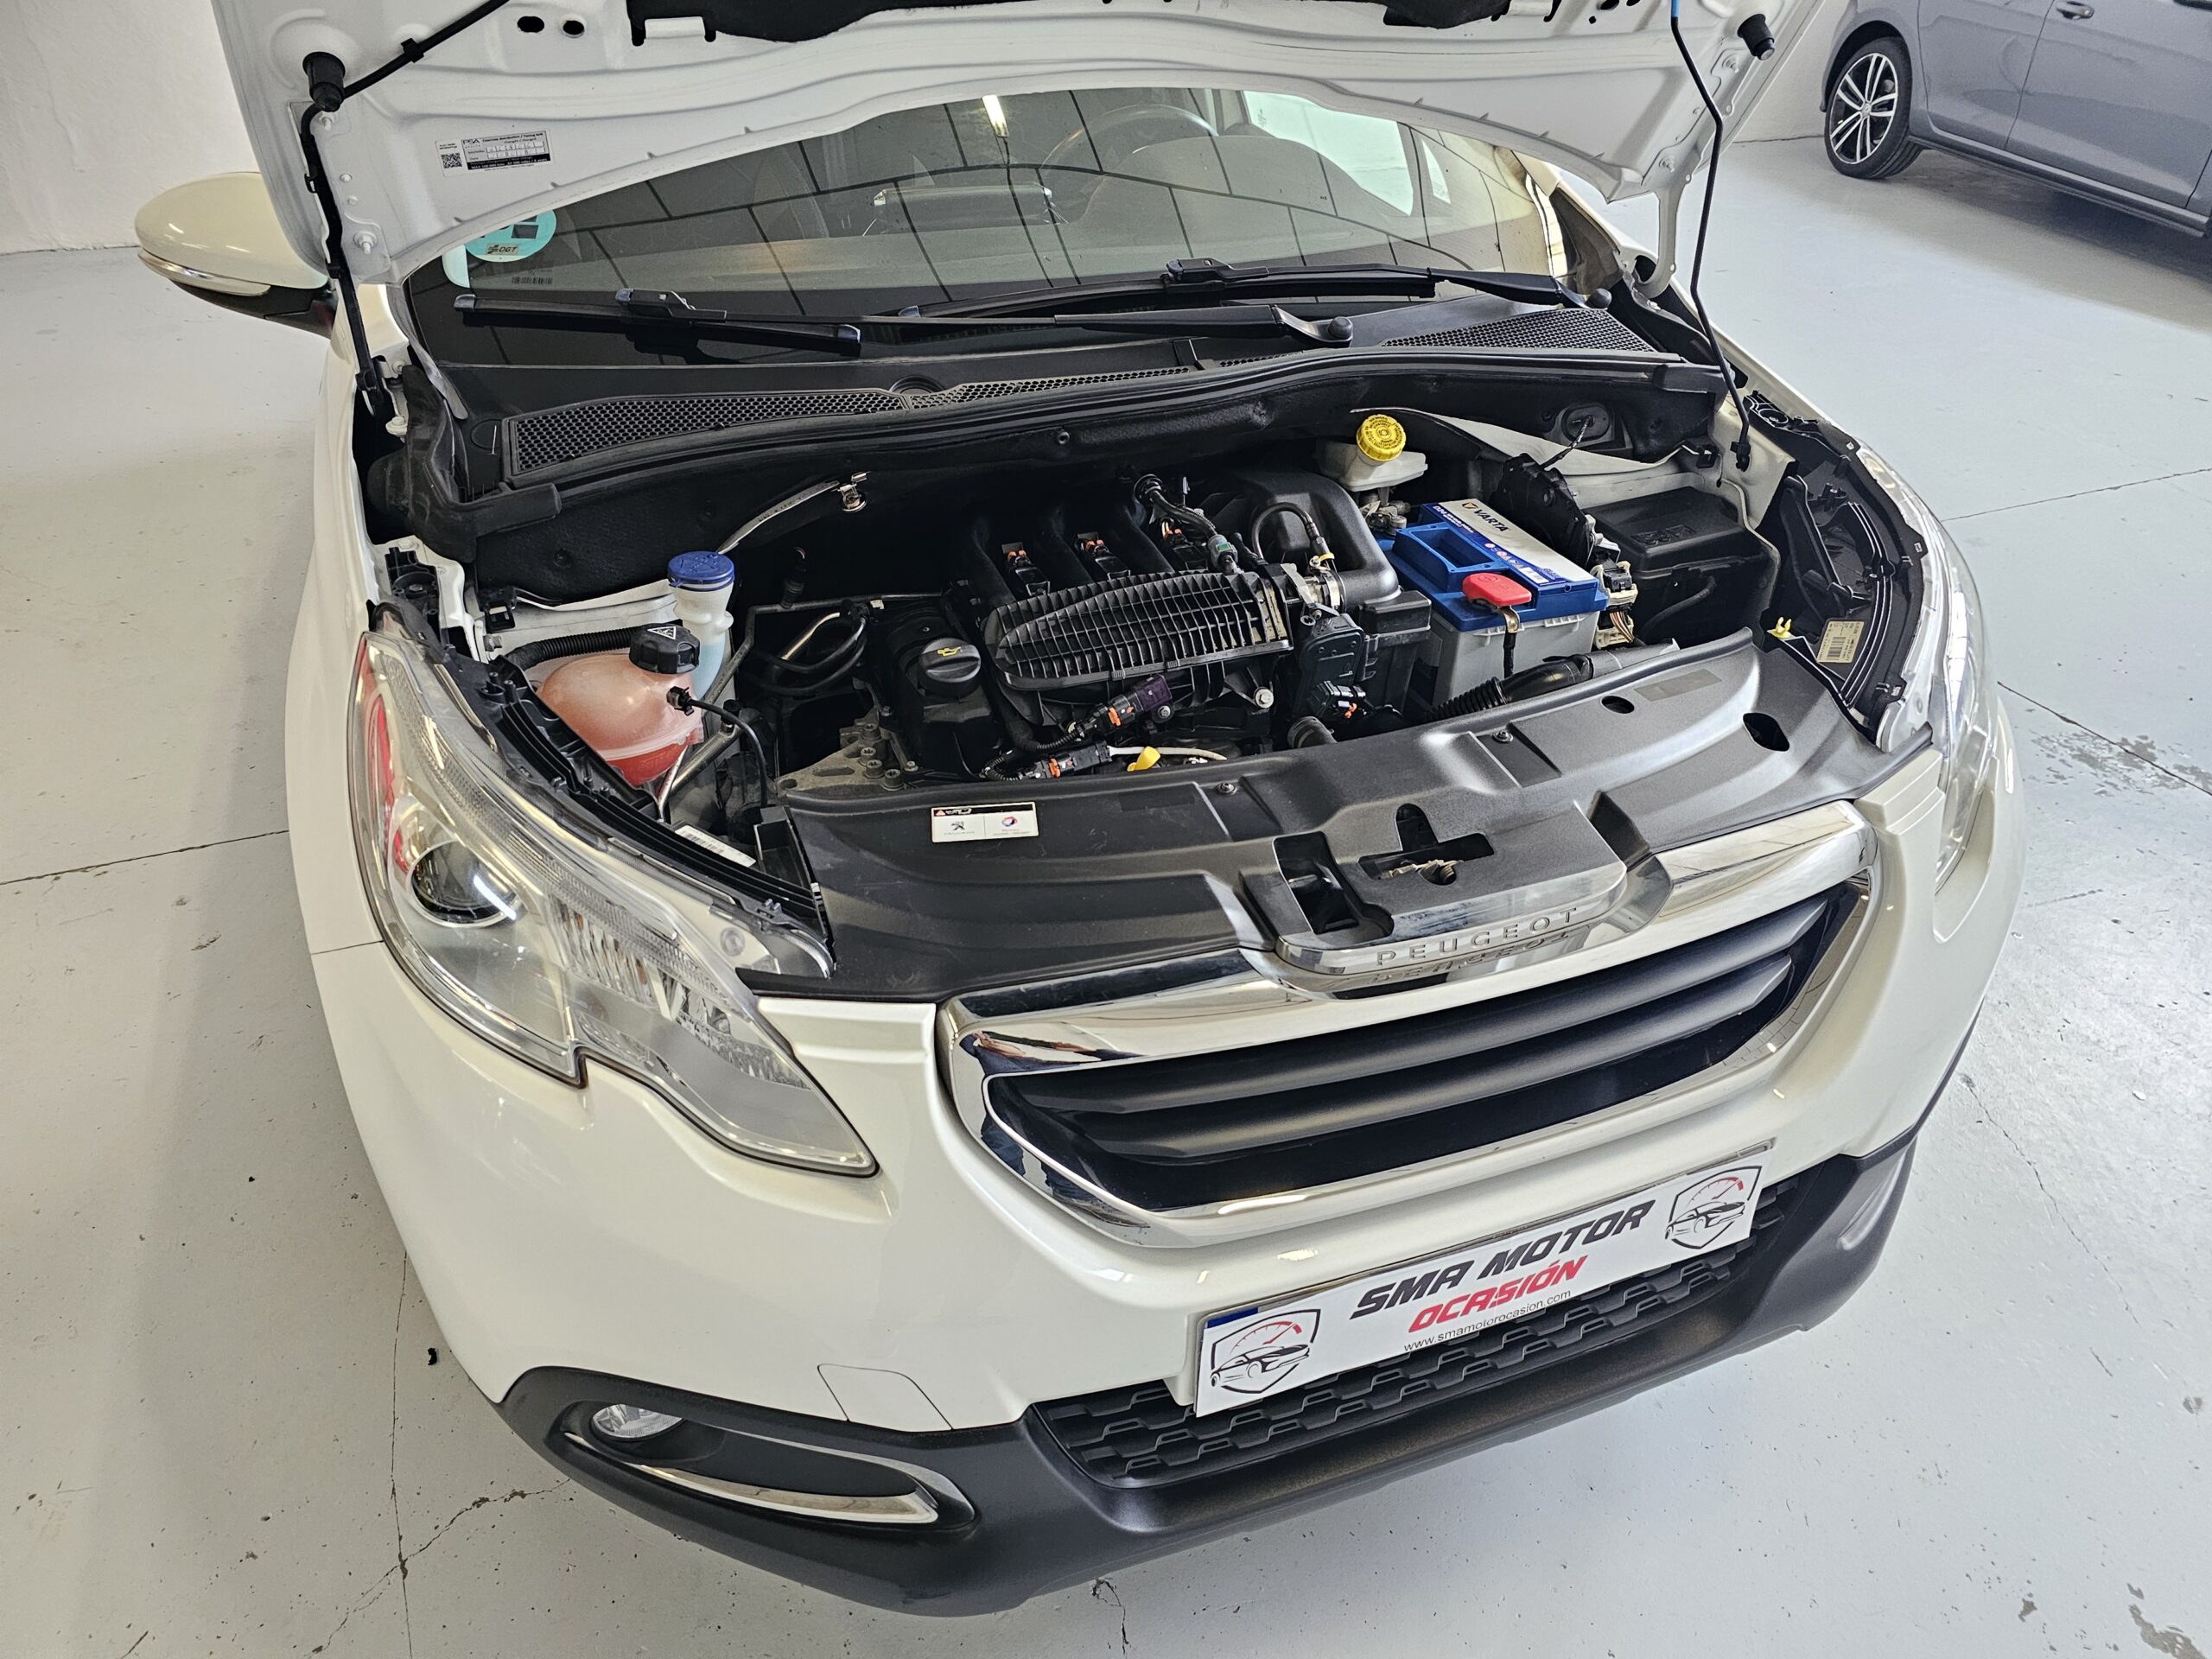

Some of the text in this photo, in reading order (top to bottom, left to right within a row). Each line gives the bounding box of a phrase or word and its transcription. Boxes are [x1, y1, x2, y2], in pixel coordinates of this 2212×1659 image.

[1473, 509, 1510, 532] VARTA
[1376, 907, 1576, 966] PEUGEOT
[1349, 1199, 1656, 1320] SMA MOTOR
[1403, 1290, 1572, 1352] www.smamotorocasion.com
[1408, 1255, 1588, 1333] OCASIÓN
